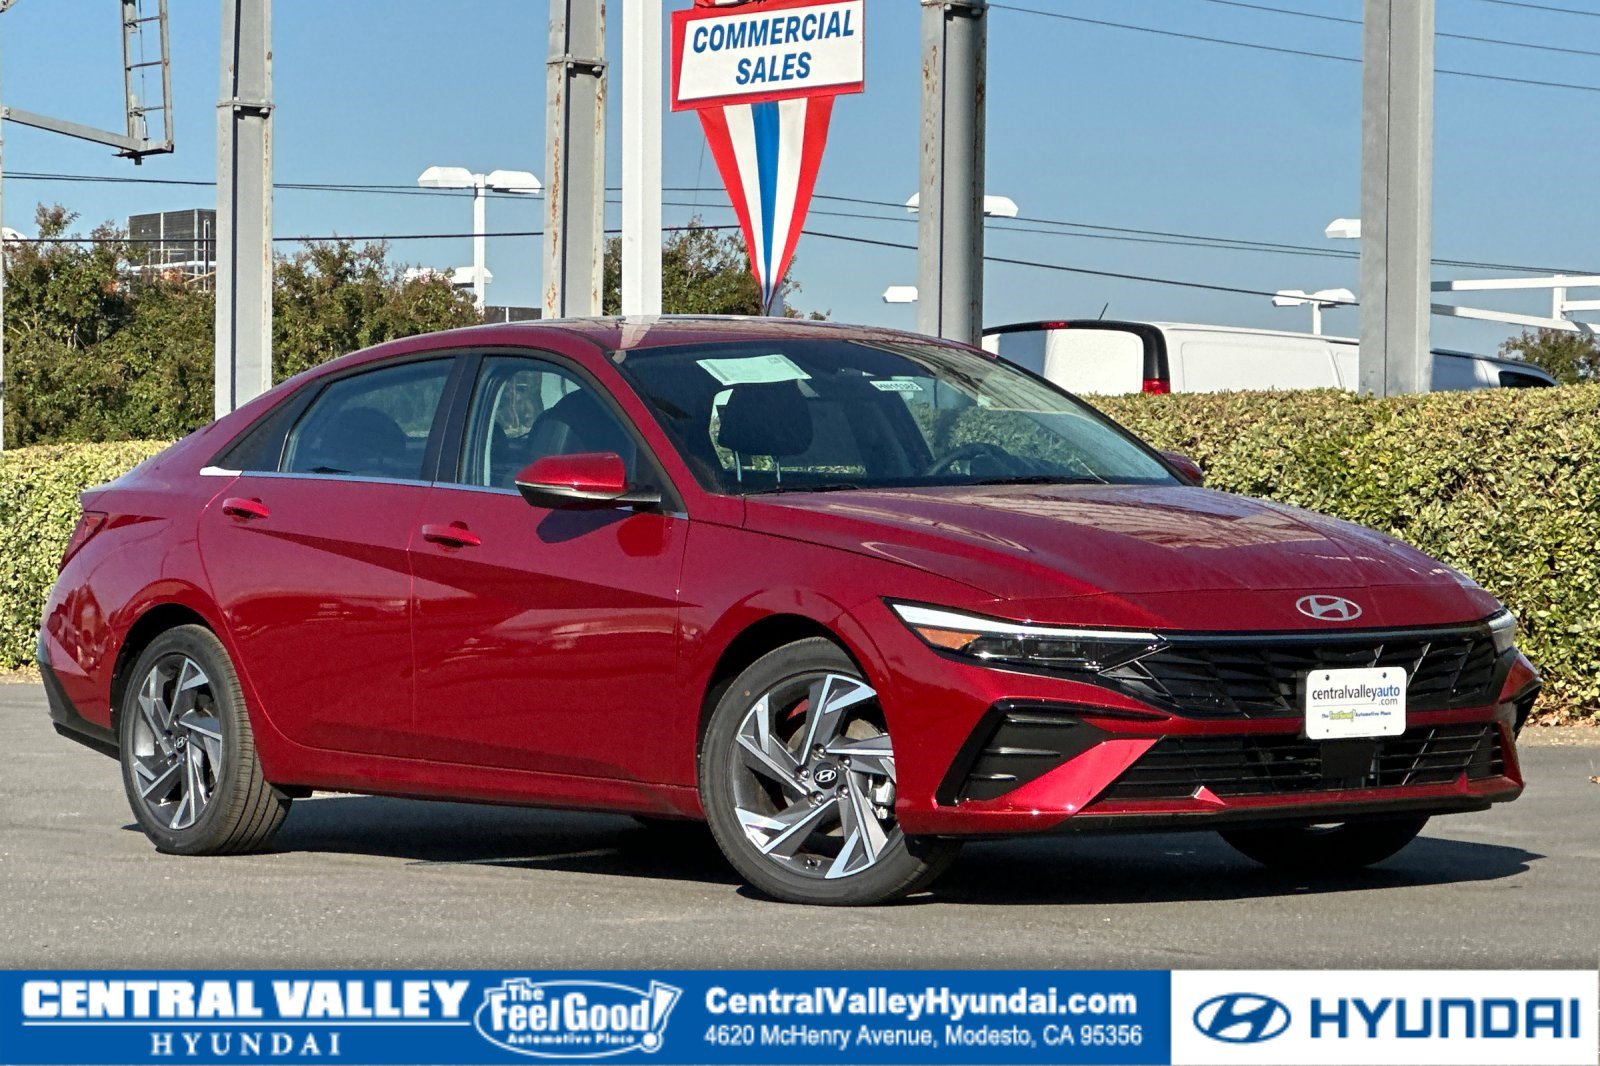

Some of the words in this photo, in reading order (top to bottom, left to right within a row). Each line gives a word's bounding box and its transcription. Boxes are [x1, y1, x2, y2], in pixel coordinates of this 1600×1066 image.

[693, 9, 854, 53] COMMERCIAL
[736, 51, 812, 85] SALES
[1312, 684, 1400, 701] centralvalleyauto
[1379, 698, 1398, 706] .com
